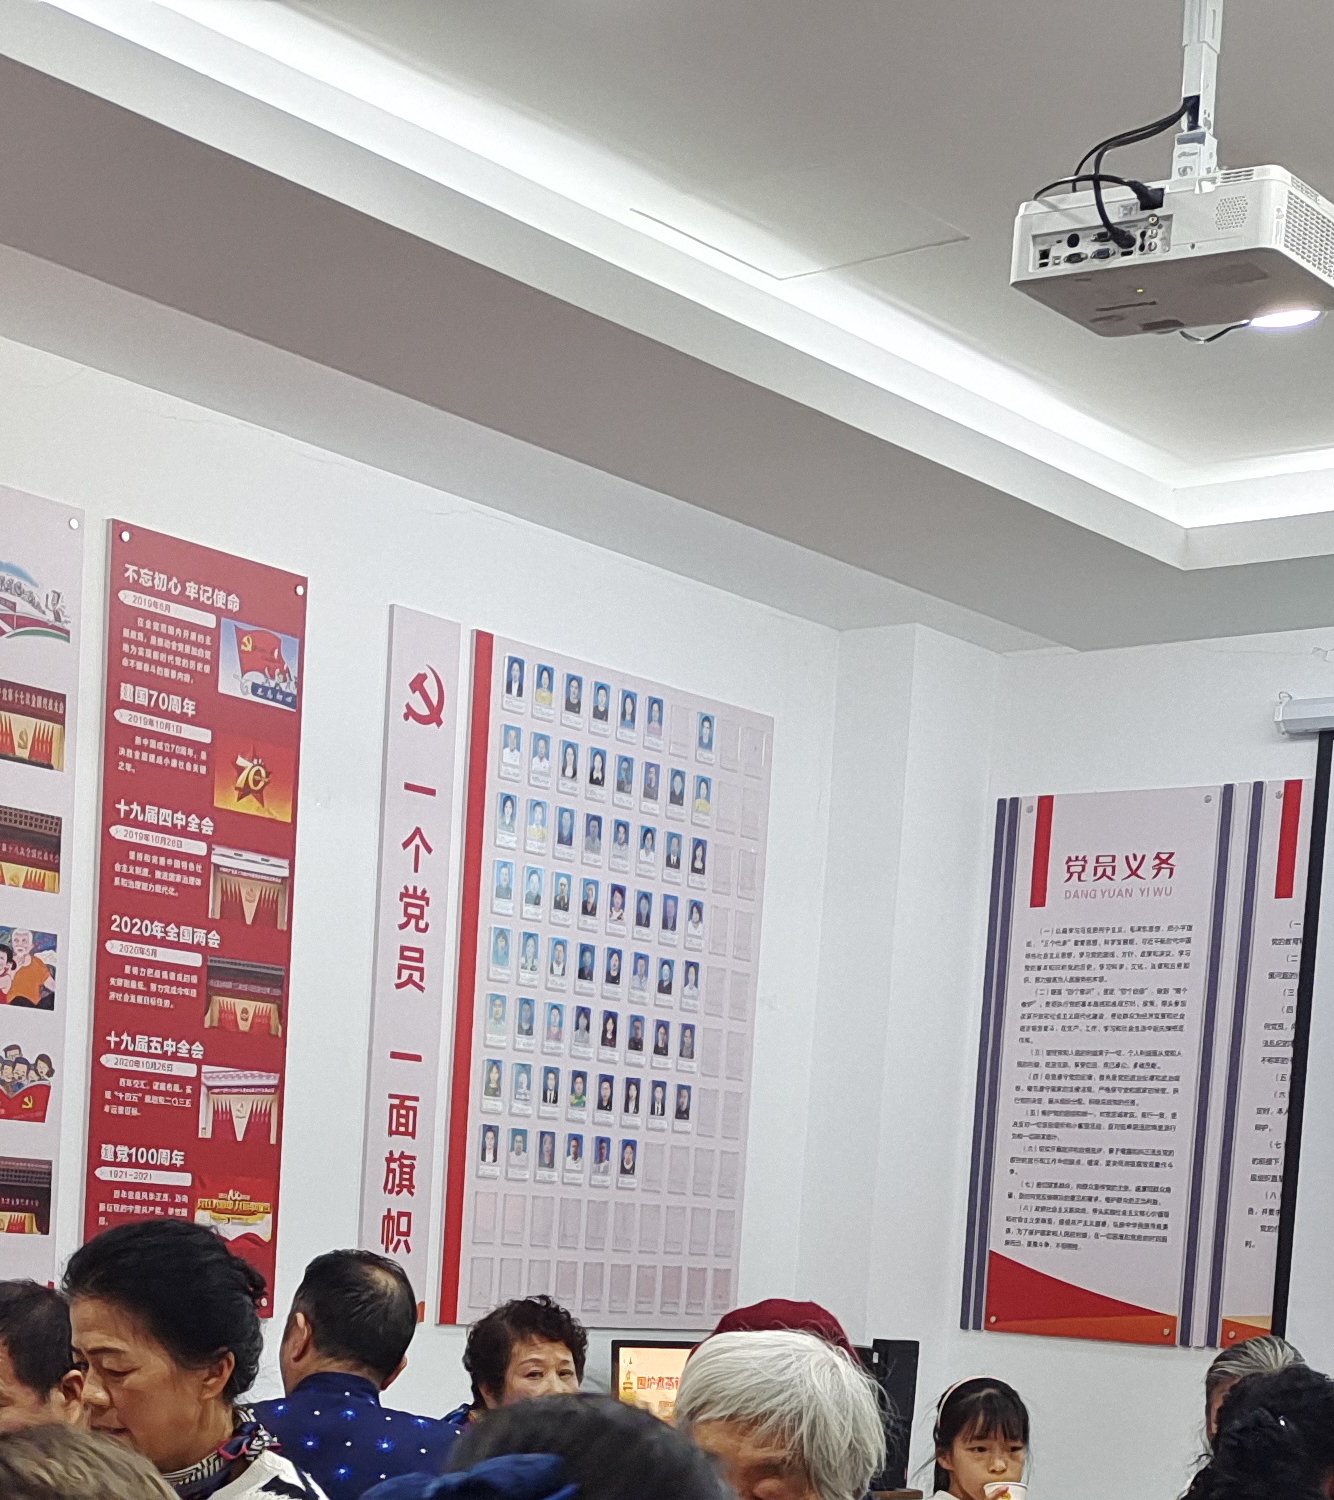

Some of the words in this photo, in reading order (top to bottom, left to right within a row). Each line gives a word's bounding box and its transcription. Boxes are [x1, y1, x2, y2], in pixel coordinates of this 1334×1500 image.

[123, 562, 181, 597] 不忘初心
[184, 580, 239, 613] 牢记使命
[119, 681, 196, 718] 建国70周年
[114, 797, 214, 835] 十九届四中全会
[1063, 851, 1176, 884] 党员义务
[394, 781, 436, 993] 一个党员
[1064, 888, 1097, 900] DANG
[1101, 888, 1133, 899] YUAN
[1139, 887, 1150, 899] YI
[1153, 886, 1173, 898] WU
[110, 913, 222, 949] 2020年全国两会
[105, 1028, 204, 1060] 十九届五中全会
[100, 1143, 184, 1167] 建党100周年
[380, 1051, 423, 1255] 一面旗帜
[637, 1375, 680, 1391] 围炉煮茶
